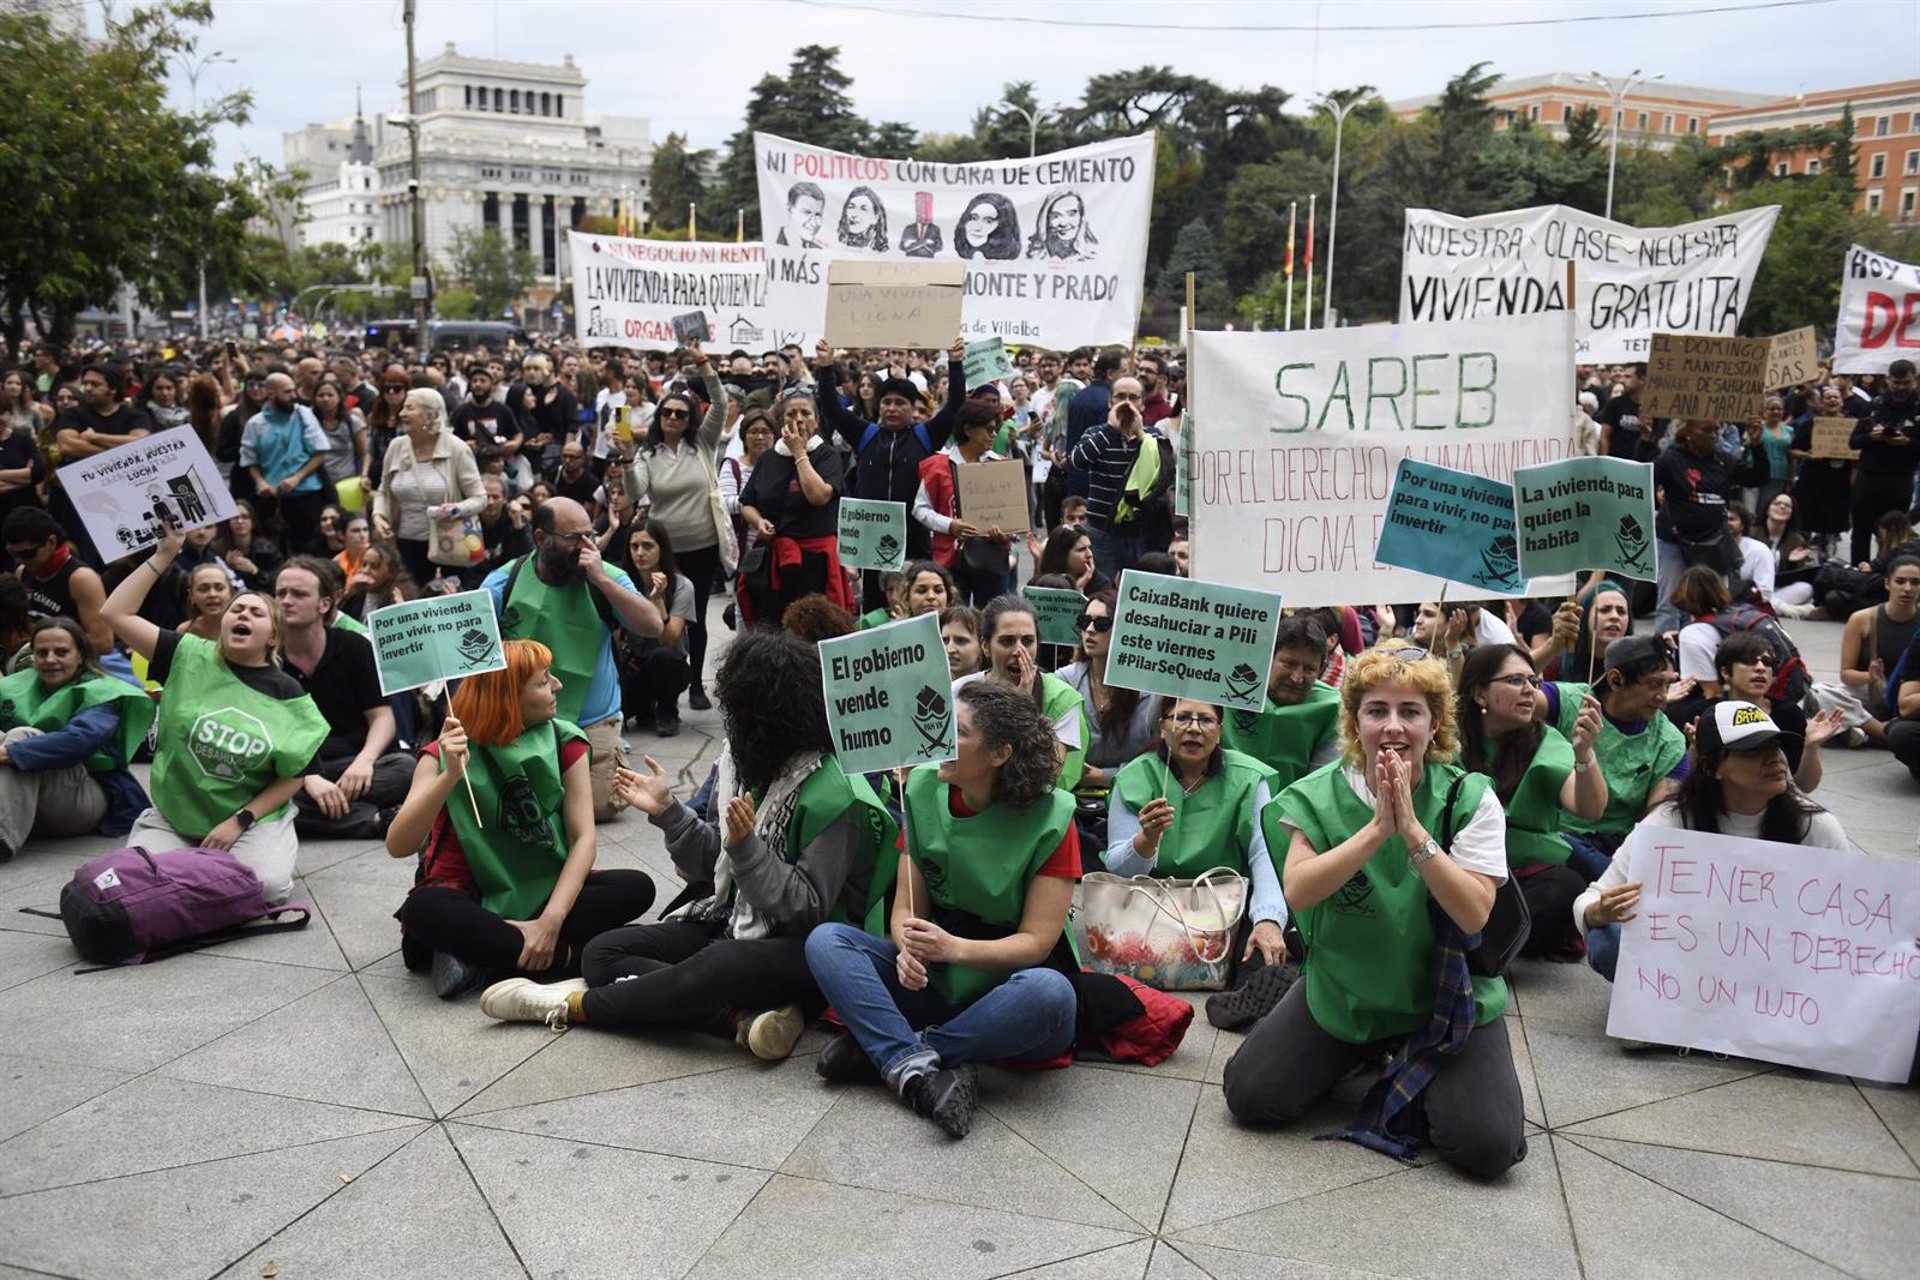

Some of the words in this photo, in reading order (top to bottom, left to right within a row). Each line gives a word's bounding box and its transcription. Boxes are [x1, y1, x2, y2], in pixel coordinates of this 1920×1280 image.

[767, 151, 786, 174] NI
[896, 160, 936, 183] CON
[943, 165, 995, 186] CARA
[1003, 166, 1030, 186] DE
[1036, 155, 1135, 186] CEMENTO
[625, 244, 696, 263] NEGOCIO
[699, 247, 716, 263] NI
[1407, 223, 1523, 260] NUESTRA
[1545, 220, 1623, 263] CLASE
[780, 253, 820, 285] MÁS
[604, 267, 670, 305] VIVIENDA
[672, 272, 707, 306] PARA
[709, 274, 751, 314] QUIEN
[1033, 273, 1047, 299] Y
[1052, 274, 1119, 302] PRADO
[1590, 276, 1741, 334] GRATUITA
[973, 319, 987, 334] de
[992, 320, 1040, 337] Villalba
[1652, 336, 1671, 353] EL
[1684, 337, 1766, 361] DOMINGO
[1269, 352, 1498, 434] SAREB
[81, 472, 96, 482] TU
[146, 440, 187, 460] NUESTRA
[127, 464, 159, 481] LUCHA
[1187, 450, 1232, 506] POR
[1239, 449, 1266, 504] EL
[1271, 446, 1389, 502] DERECHO
[1400, 469, 1427, 489] Por
[1429, 478, 1457, 497] una
[1521, 486, 1544, 505] La
[1548, 475, 1615, 501] vivienda
[1617, 482, 1644, 502] para
[1390, 509, 1448, 536] invertir
[1394, 492, 1430, 512] para
[1432, 500, 1468, 522] vivir,
[1470, 510, 1490, 525] no
[1523, 506, 1573, 531] quien
[1576, 501, 1591, 520] la
[1263, 514, 1359, 574] DIGNA
[1525, 528, 1581, 553] habita
[375, 617, 396, 631] Por
[397, 612, 420, 626] una
[422, 600, 472, 619] vivienda
[1128, 586, 1211, 614] CaixaBank
[1214, 602, 1269, 624] quiere
[378, 631, 405, 649] para
[438, 621, 453, 632] no
[455, 616, 482, 632] para
[1124, 608, 1212, 638] desahuciar
[1214, 627, 1225, 639] a
[1229, 625, 1257, 645] Pili
[381, 641, 425, 662] invertir
[831, 655, 851, 681] El
[852, 642, 926, 683] gobierno
[1120, 633, 1153, 651] este
[1156, 638, 1216, 662] viernes
[1116, 651, 1222, 684] #PilarSeQueda
[835, 685, 890, 717] vende
[198, 719, 266, 758] STOP
[840, 726, 893, 752] humo
[1655, 845, 1779, 910] TENER
[1799, 878, 1894, 933] CASA
[1648, 911, 1698, 953] ES
[1718, 920, 1771, 962] UN
[1638, 966, 1681, 1001] NO
[1698, 975, 1738, 1004] UN
[1754, 984, 1820, 1027] LUJO
